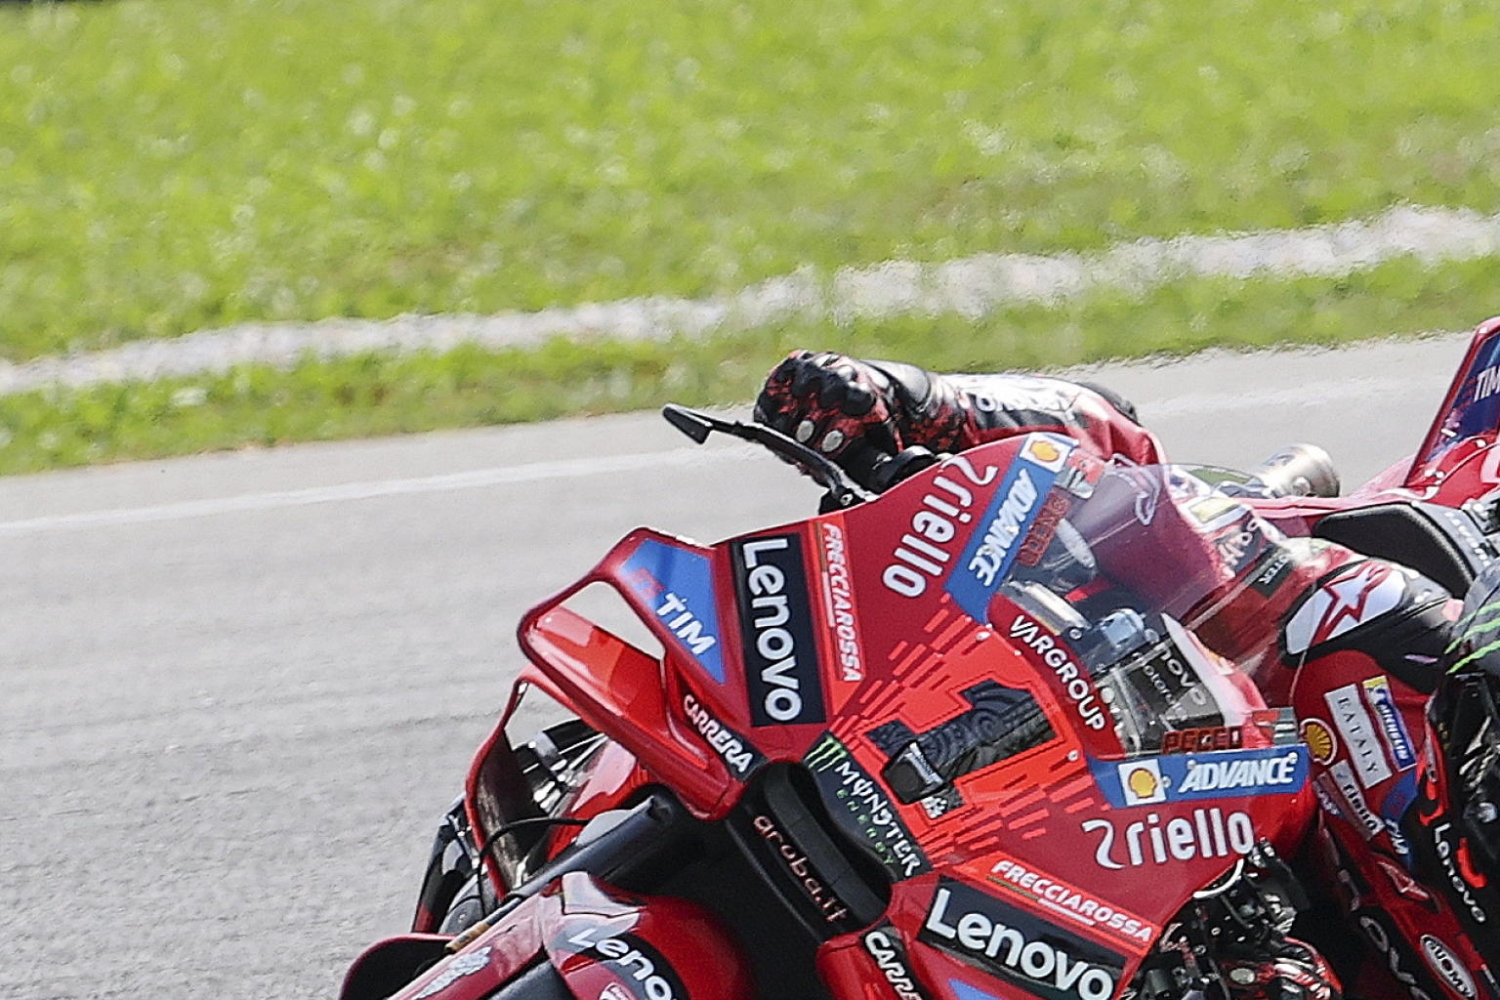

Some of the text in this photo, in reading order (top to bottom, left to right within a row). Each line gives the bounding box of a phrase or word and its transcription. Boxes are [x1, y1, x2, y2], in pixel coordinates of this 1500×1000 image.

[969, 469, 1041, 586] ADVANCE
[655, 592, 717, 655] TIM
[742, 538, 802, 721] Lenovo
[822, 523, 861, 682] FRECCIAROSSA
[1009, 614, 1106, 731] VARGROUP
[683, 694, 755, 774] CARRERA
[1178, 757, 1295, 793] ADVANCE
[1336, 697, 1379, 773] EATALY
[752, 814, 847, 923] aruba.it
[990, 860, 1153, 943] FRECCIAROSSA
[1434, 823, 1486, 923] Lenovo
